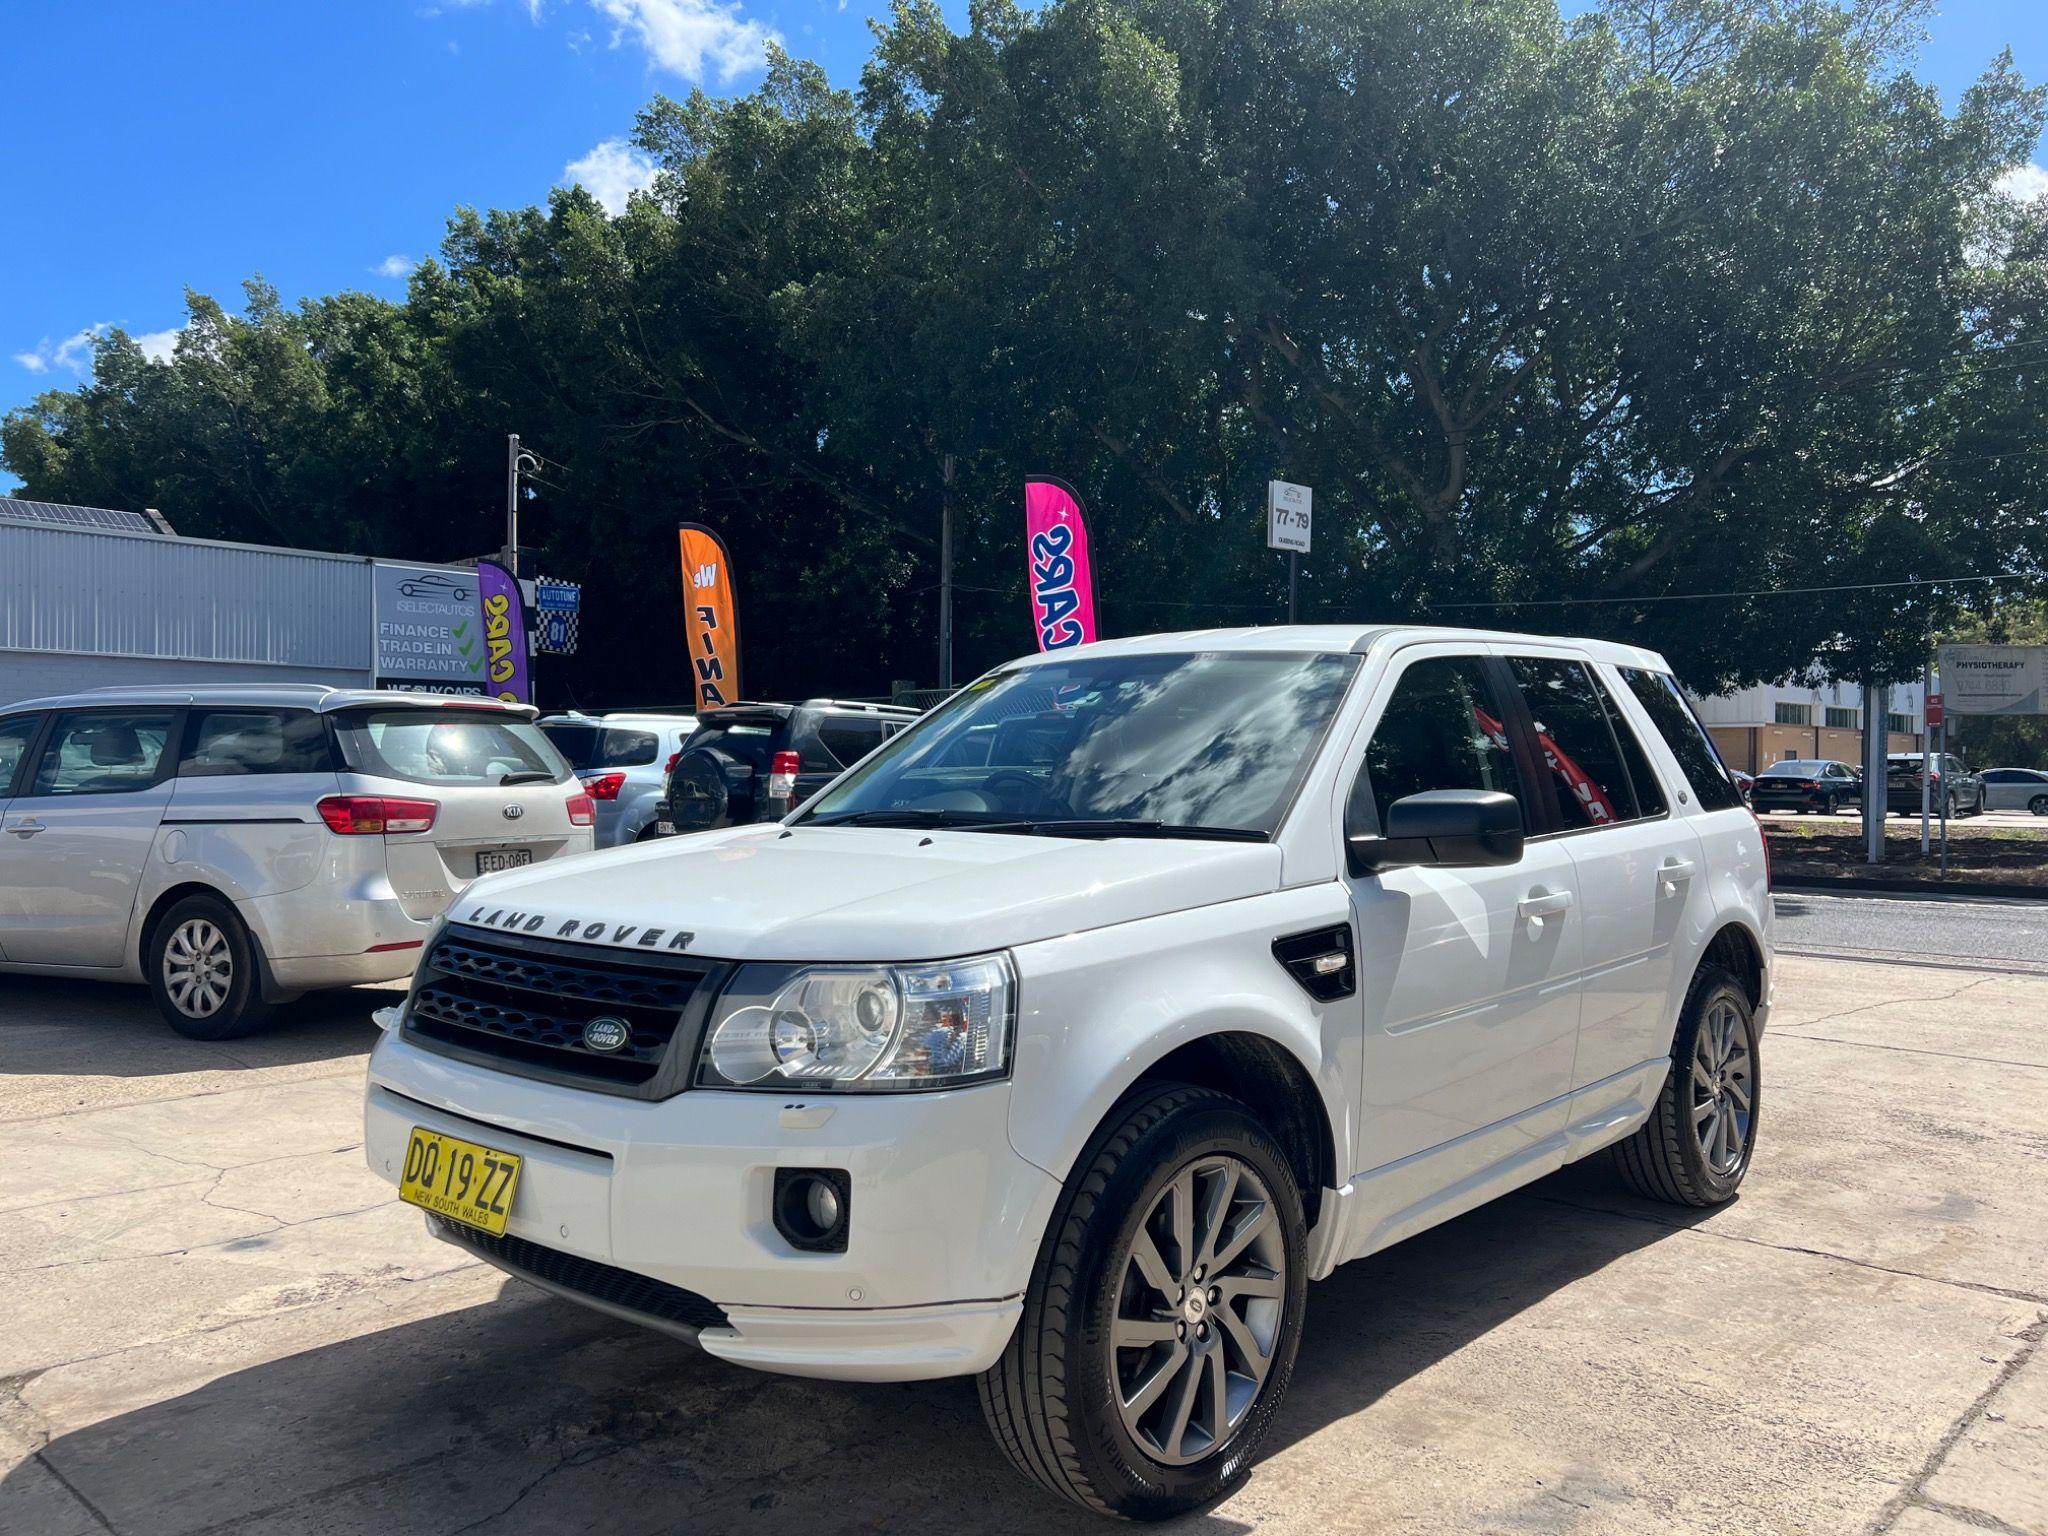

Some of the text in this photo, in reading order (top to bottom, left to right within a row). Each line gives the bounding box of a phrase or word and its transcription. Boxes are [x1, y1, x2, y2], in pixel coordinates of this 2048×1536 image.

[542, 590, 576, 602] AUTOTUNE
[380, 622, 449, 638] FINANCE
[550, 622, 565, 642] 81
[380, 640, 452, 655] TRADE IN
[380, 656, 468, 672] WARRANTY
[1956, 662, 2025, 670] PHYSIOTHERAPY
[506, 807, 522, 816] KIA
[468, 906, 696, 950] LAND ROVER
[592, 1022, 615, 1034] LAND
[592, 1033, 619, 1045] ROVER
[415, 1188, 489, 1224] NEW SOUTH WALES
